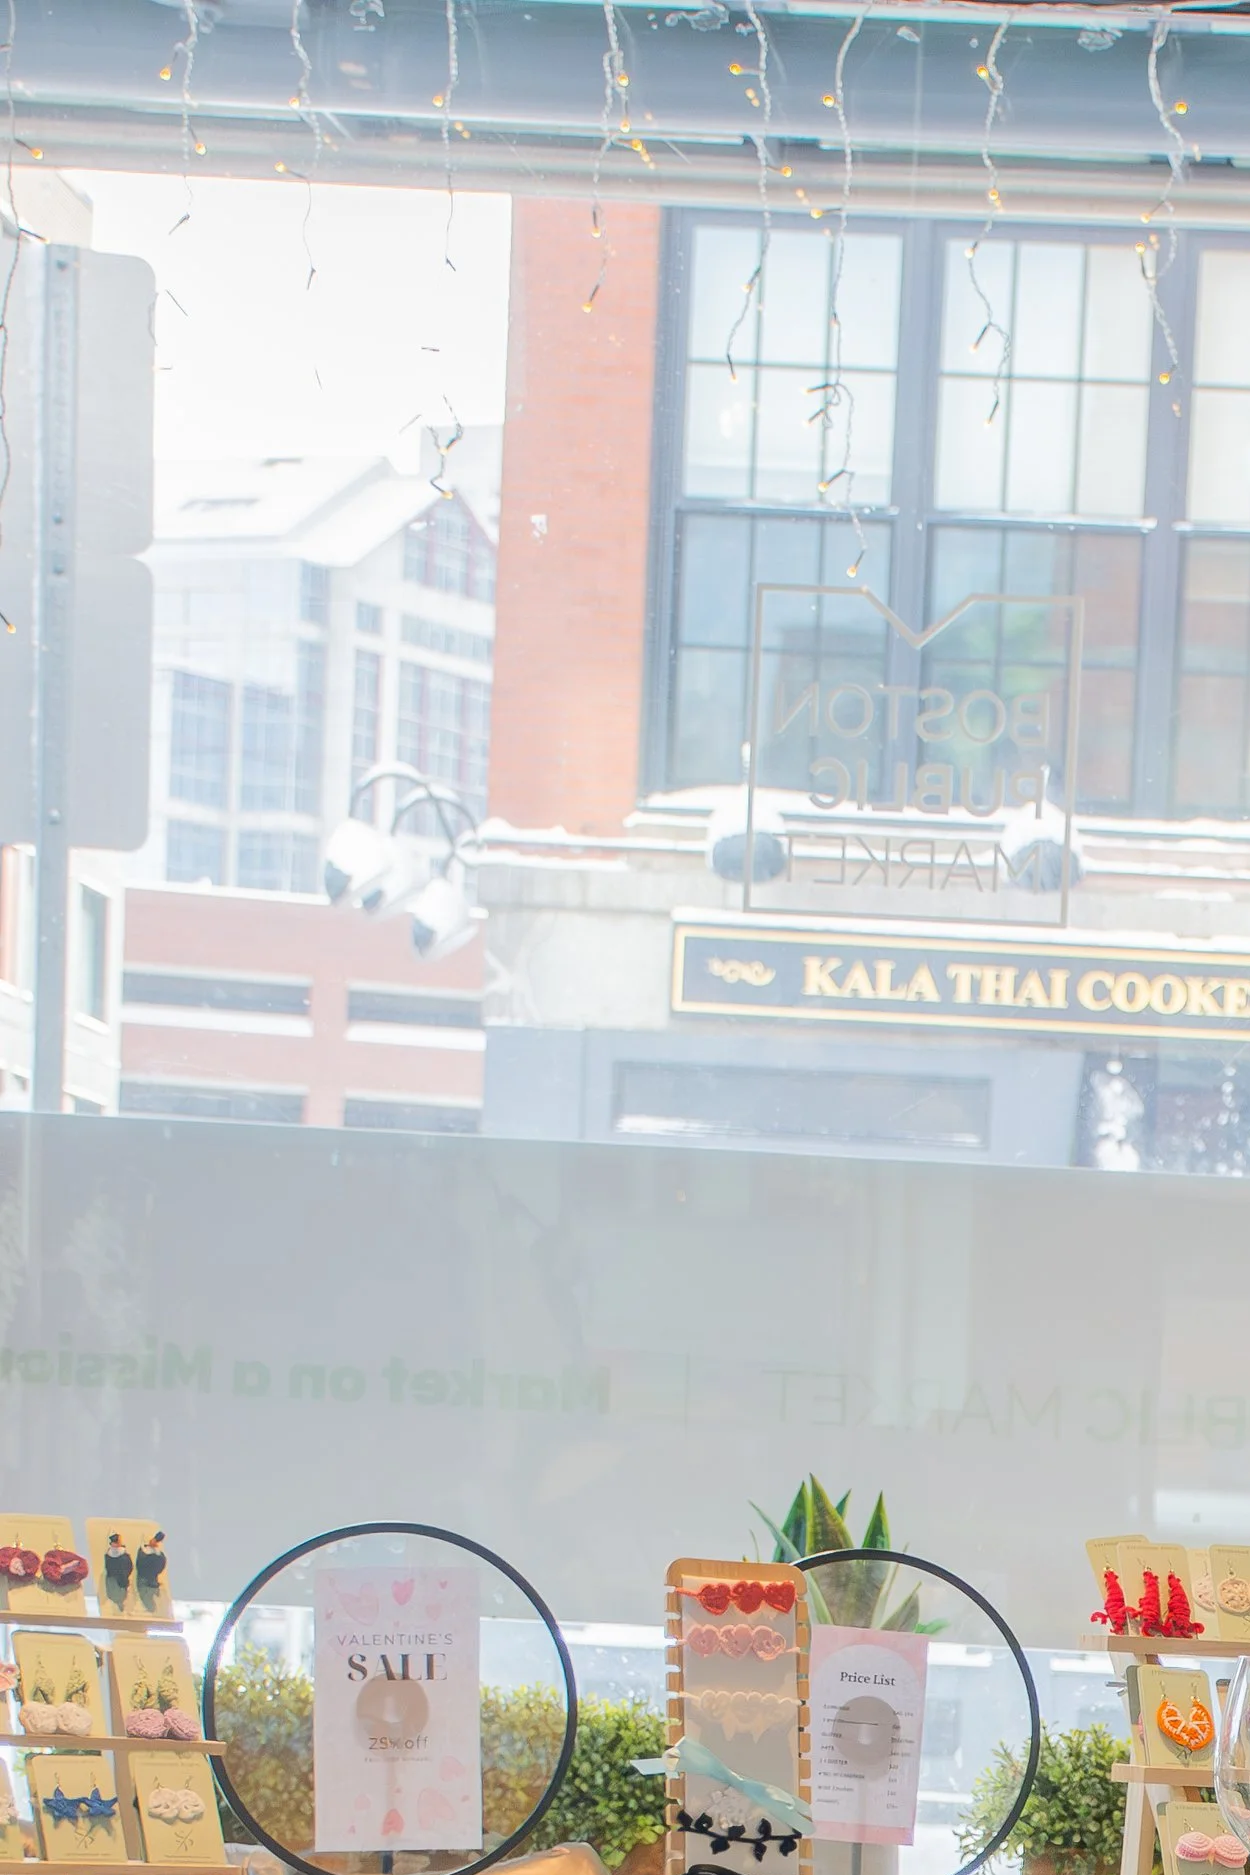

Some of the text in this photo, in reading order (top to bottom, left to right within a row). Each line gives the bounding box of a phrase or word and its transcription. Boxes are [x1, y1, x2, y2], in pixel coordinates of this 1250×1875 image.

[801, 955, 942, 1003] KALA
[946, 963, 1071, 1009] THAI
[337, 1632, 453, 1646] VALENTINE'S
[347, 1653, 448, 1681] SALE
[840, 1671, 896, 1686] Price List
[405, 1735, 429, 1750] off
